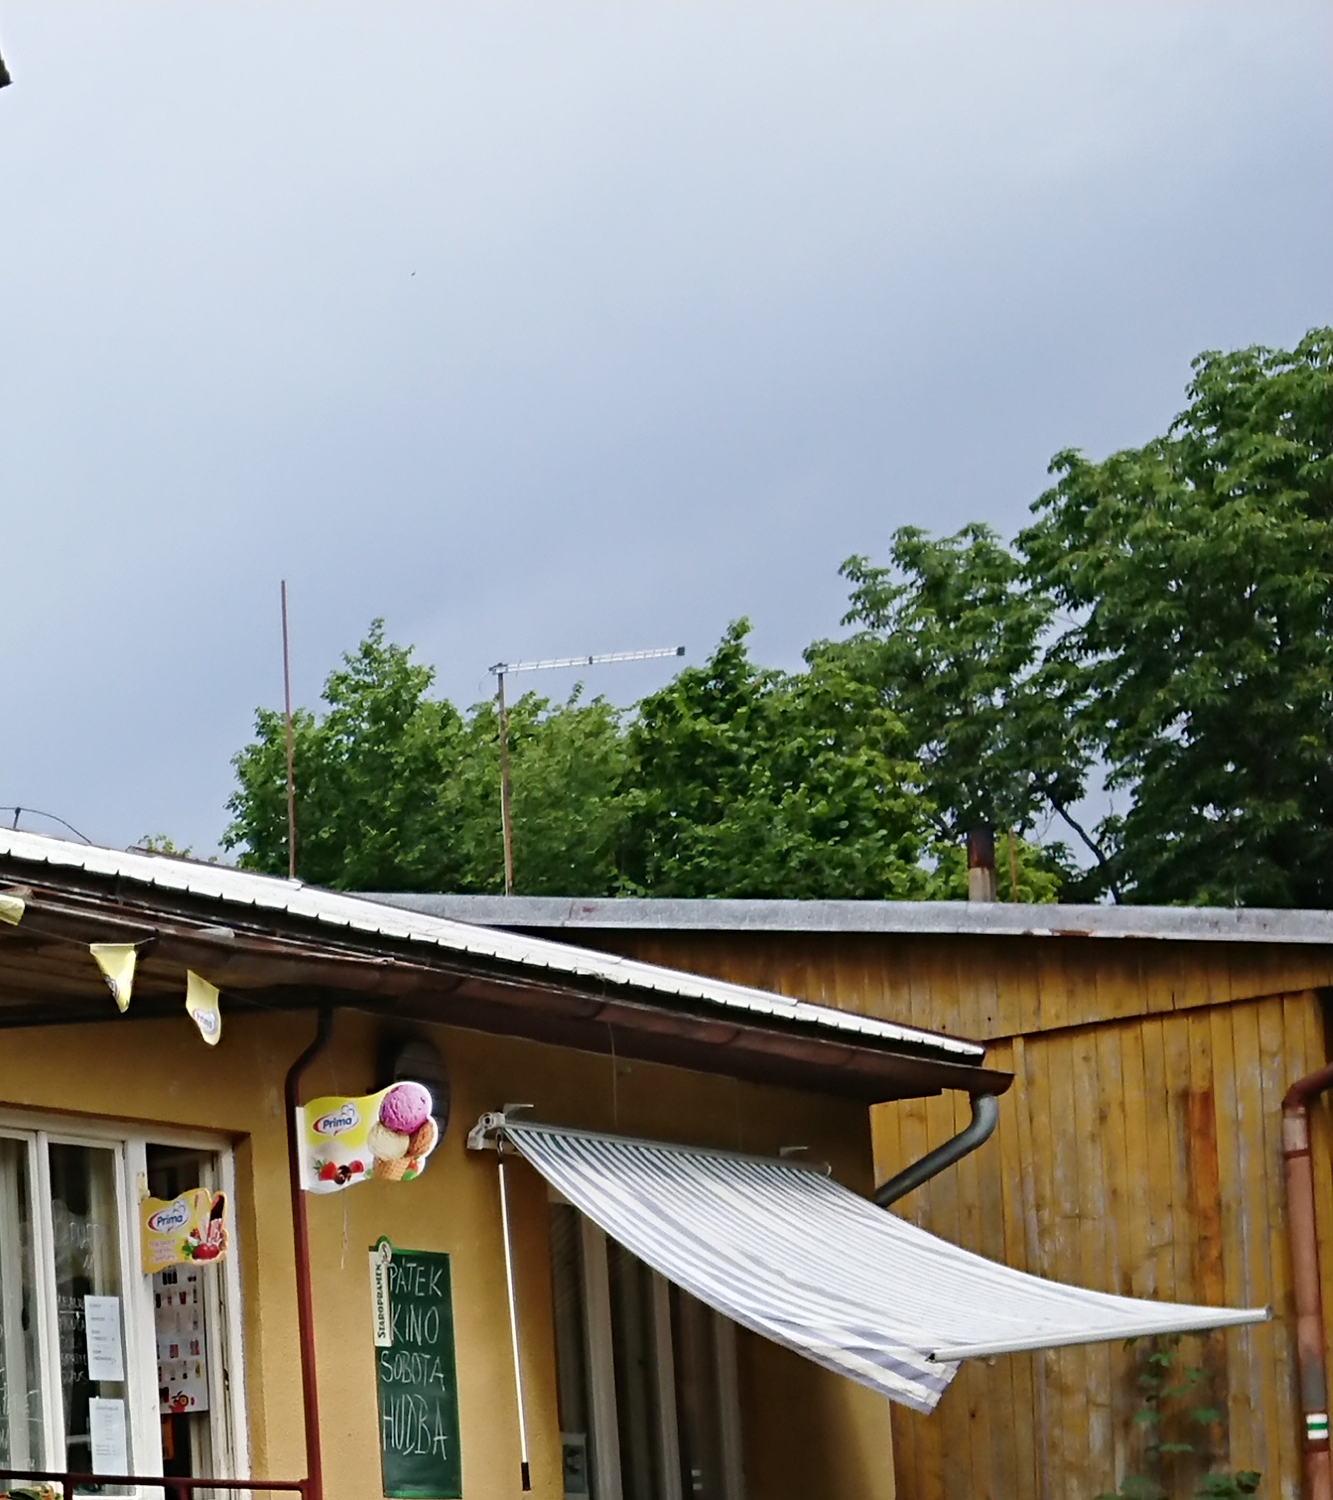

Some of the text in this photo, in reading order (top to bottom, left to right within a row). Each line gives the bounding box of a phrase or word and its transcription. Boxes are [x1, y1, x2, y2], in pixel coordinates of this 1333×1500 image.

[323, 1117, 352, 1129] Prima
[156, 1214, 183, 1228] Prima
[389, 1257, 443, 1297] PÁTEK
[377, 1263, 387, 1339] STAROPRAMEN
[390, 1301, 440, 1346] KINO
[381, 1350, 445, 1391] SOBOTA
[382, 1393, 448, 1460] HUDBA
